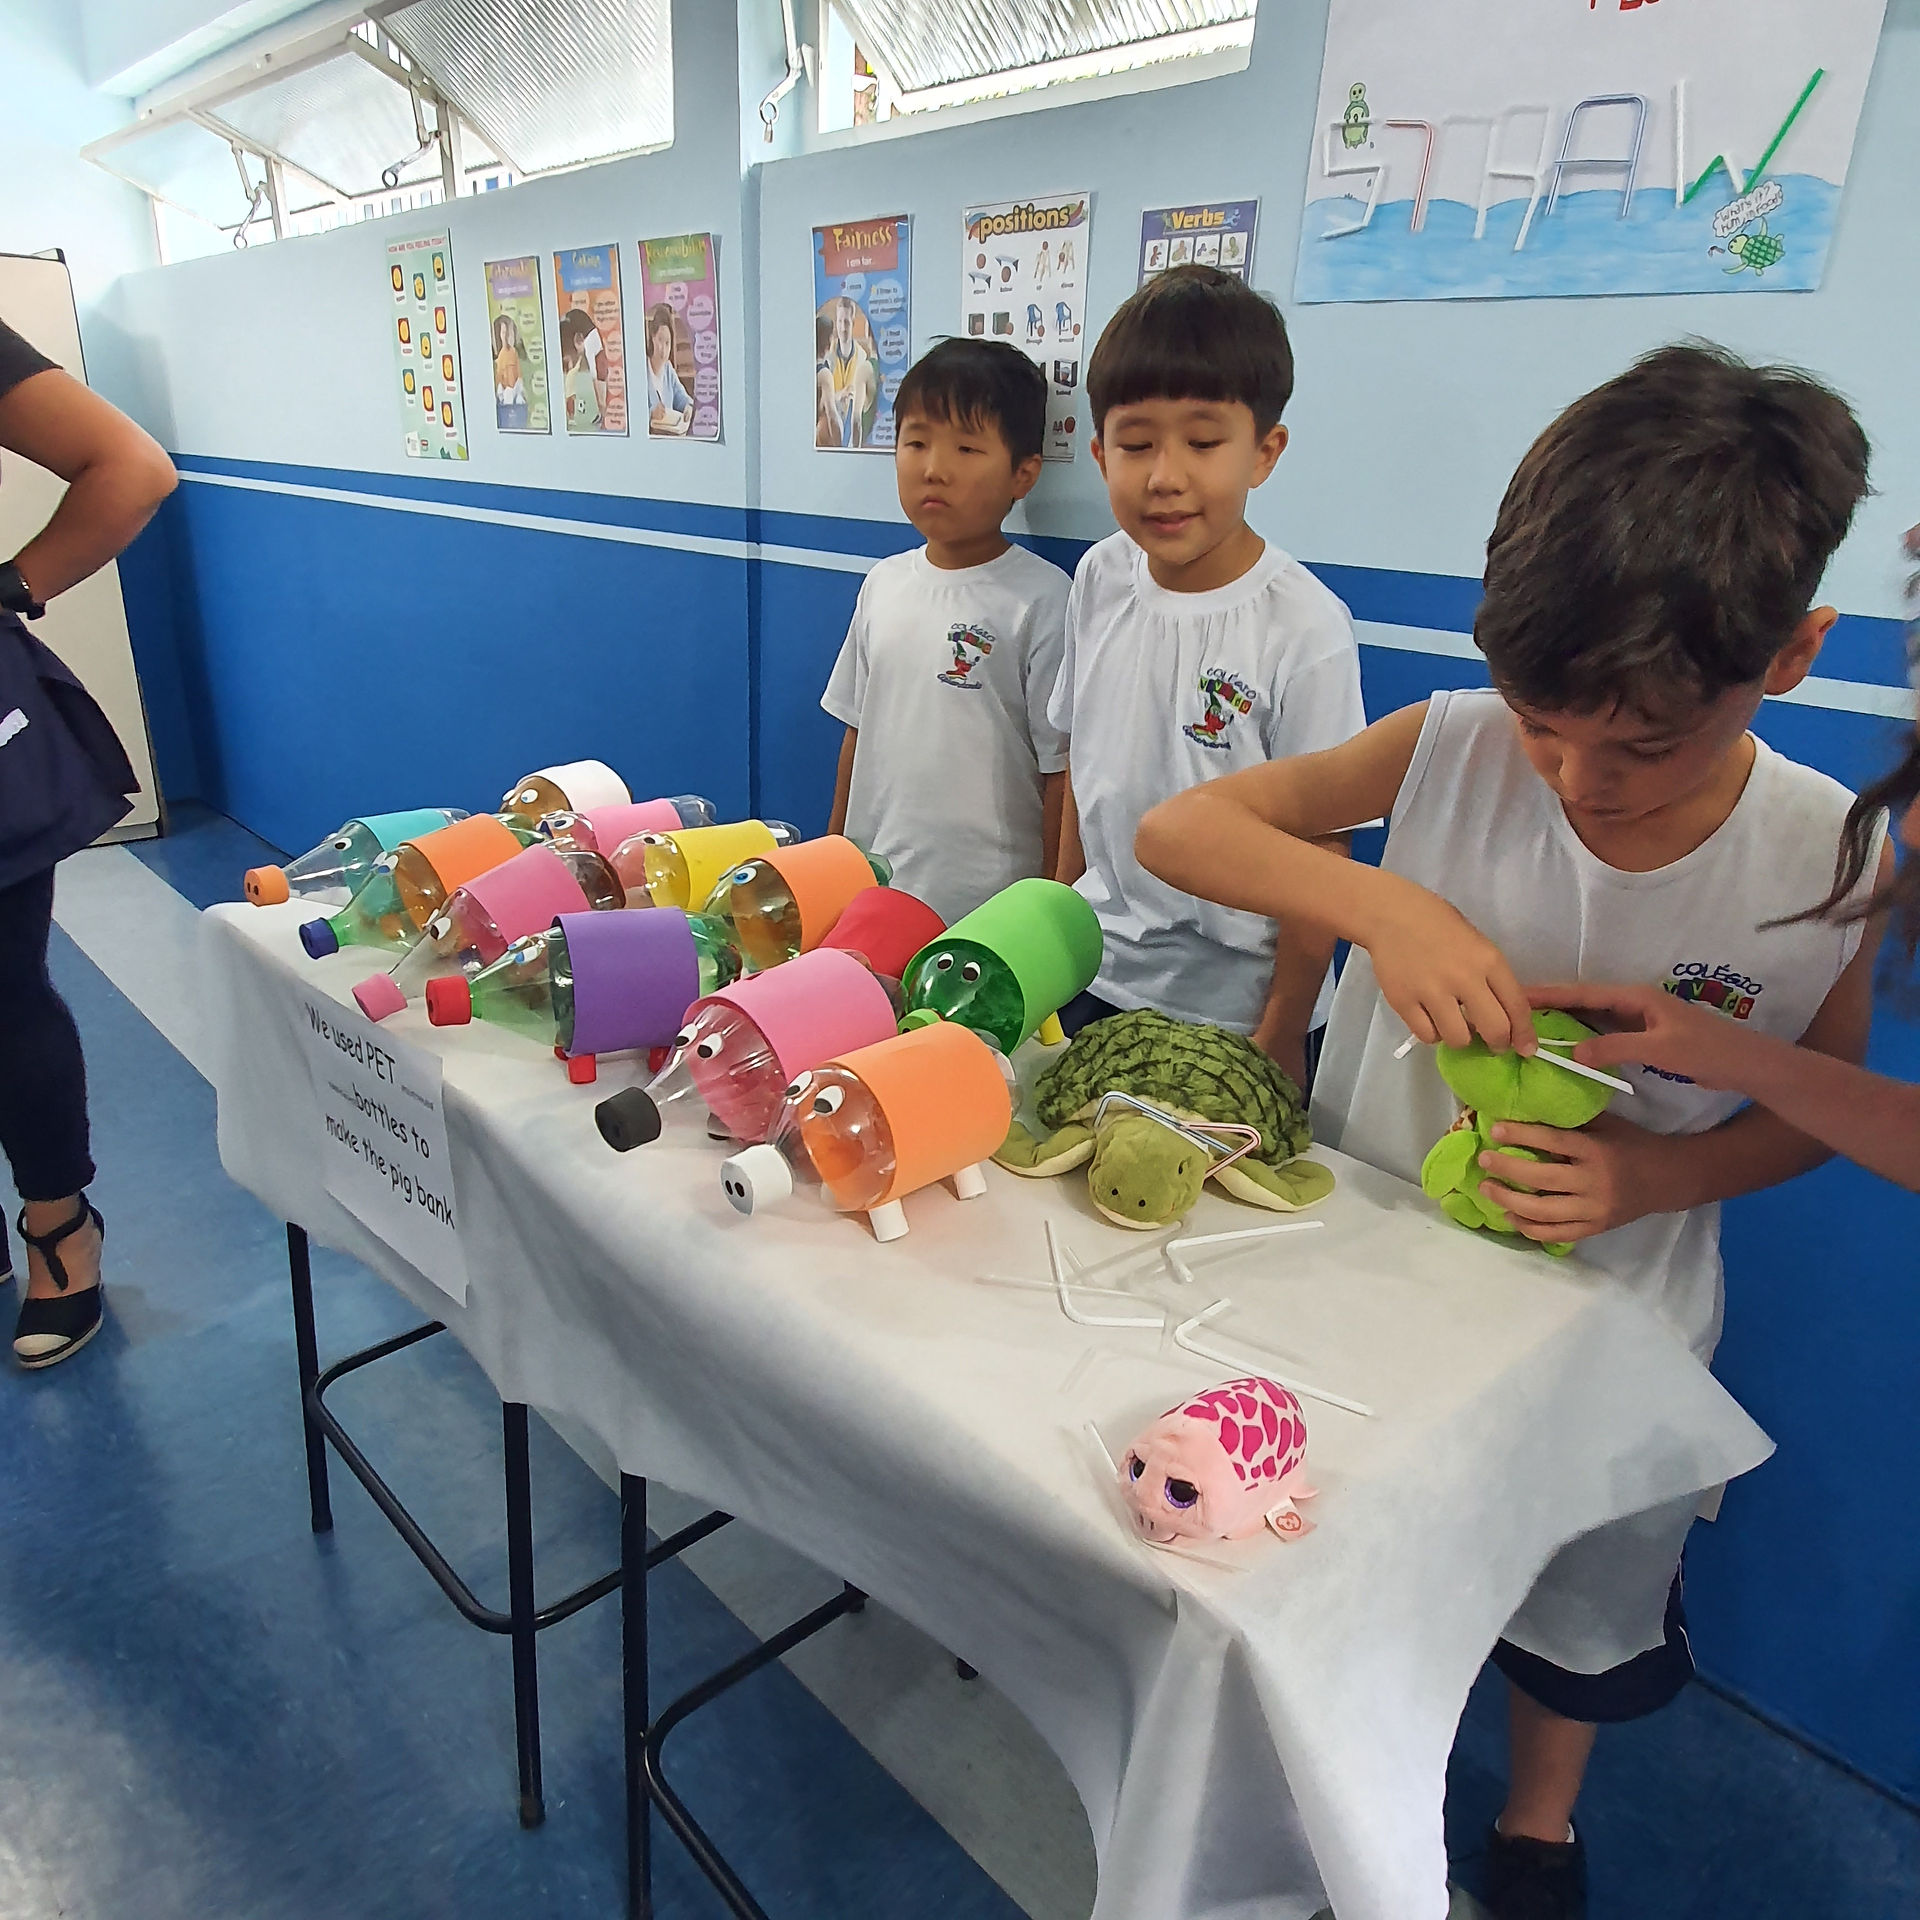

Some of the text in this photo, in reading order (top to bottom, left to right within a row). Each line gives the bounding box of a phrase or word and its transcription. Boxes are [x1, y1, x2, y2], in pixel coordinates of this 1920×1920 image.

[832, 225, 893, 252] Fairness
[978, 203, 1070, 244] positions
[1172, 208, 1225, 230] Verbs
[1672, 962, 1764, 996] COLÉGIO
[305, 1002, 396, 1084] We used PET
[352, 1082, 408, 1144] bottles
[410, 1126, 430, 1159] to
[325, 1112, 456, 1230] make the pig bank
